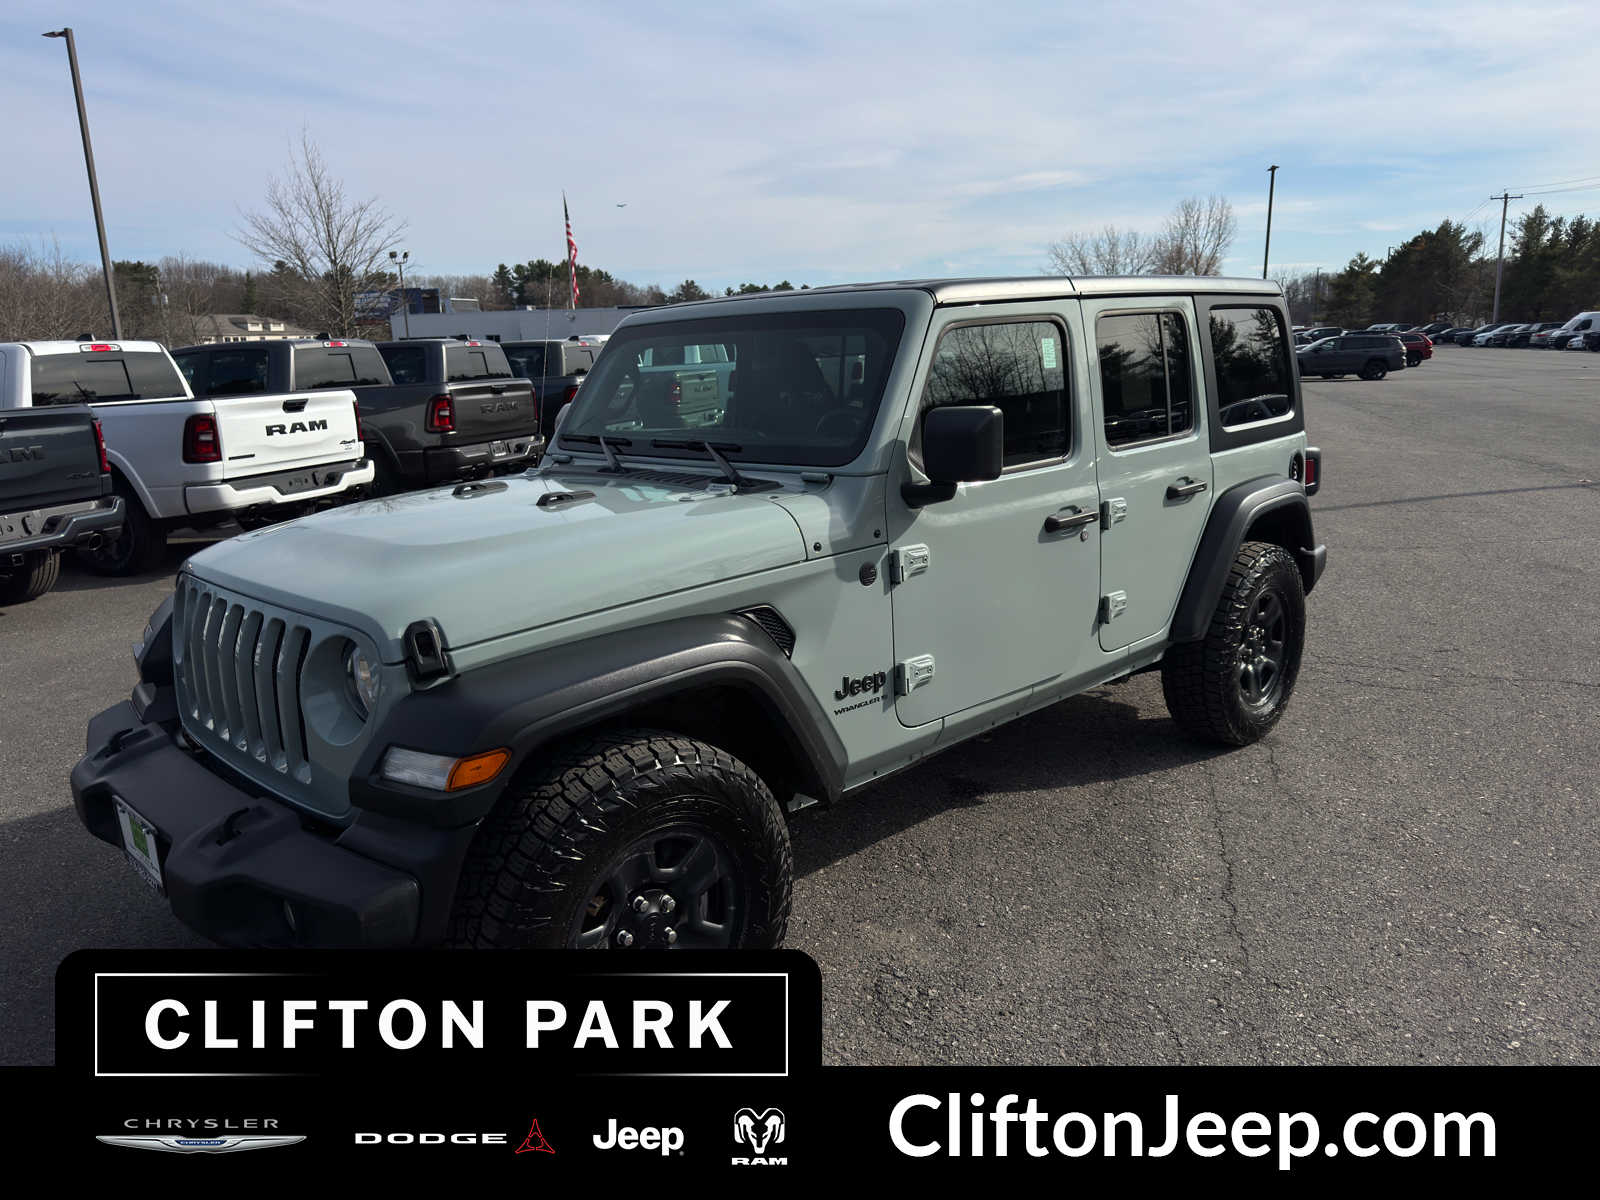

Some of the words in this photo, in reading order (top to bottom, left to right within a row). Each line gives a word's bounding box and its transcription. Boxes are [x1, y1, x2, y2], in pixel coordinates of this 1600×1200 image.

[265, 420, 328, 436] RAM
[834, 672, 886, 701] Jeep
[834, 698, 881, 715] WRANGLER
